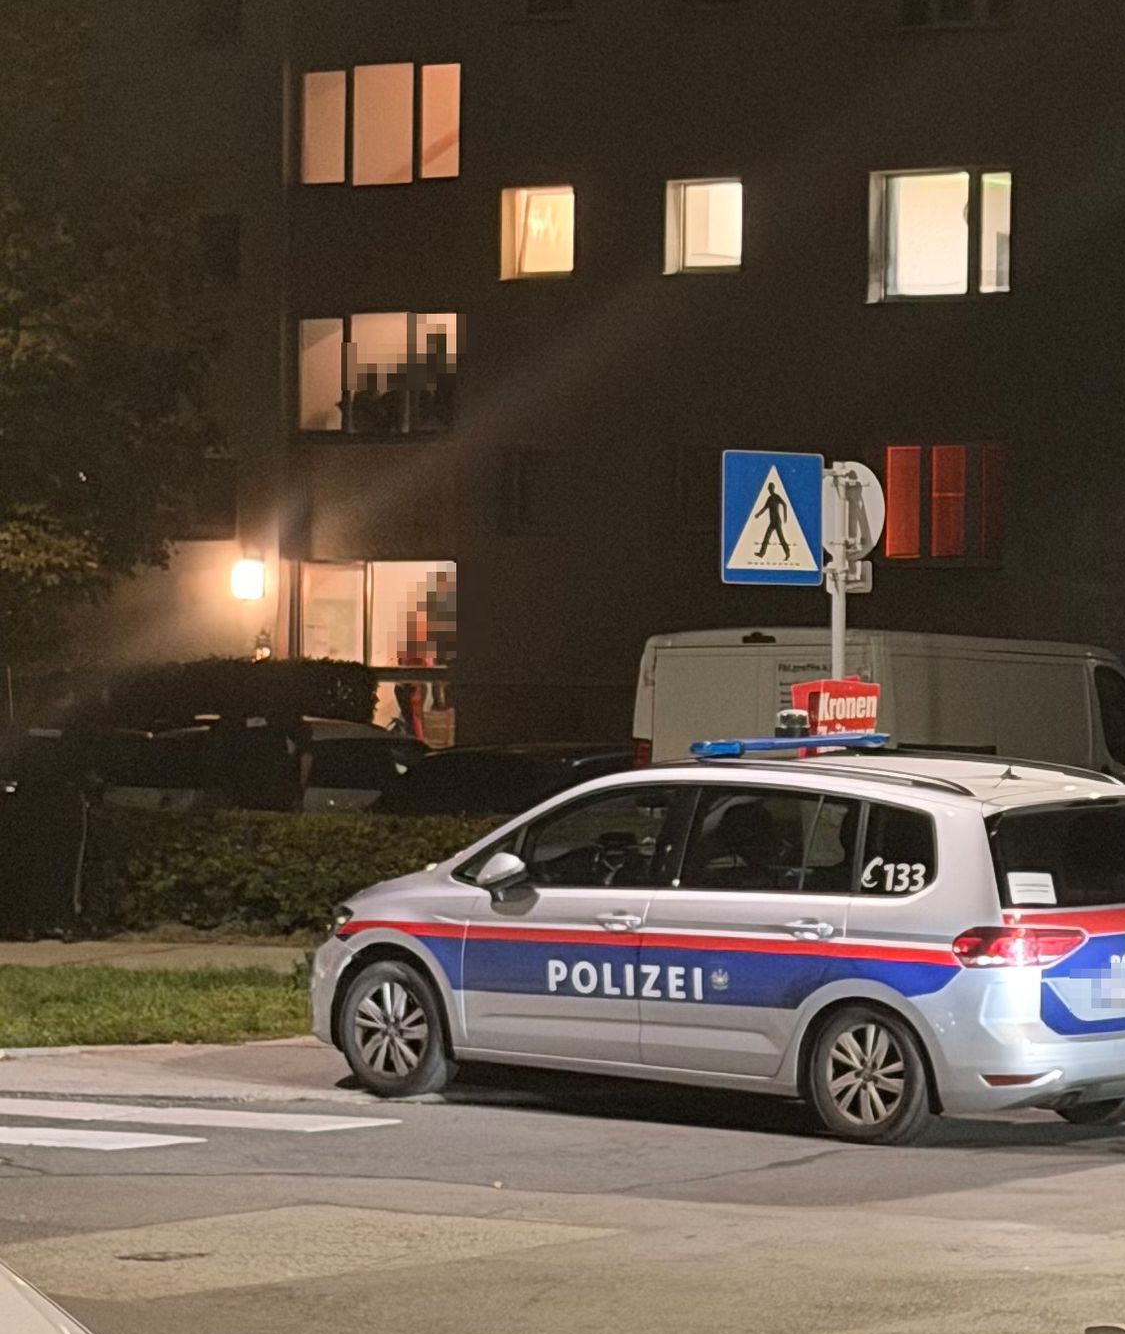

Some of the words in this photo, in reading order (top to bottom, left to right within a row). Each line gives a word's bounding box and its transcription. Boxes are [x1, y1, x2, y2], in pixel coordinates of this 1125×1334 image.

[818, 692, 878, 721] Kronen
[883, 863, 927, 892] 133
[548, 959, 704, 1001] POLIZEI
